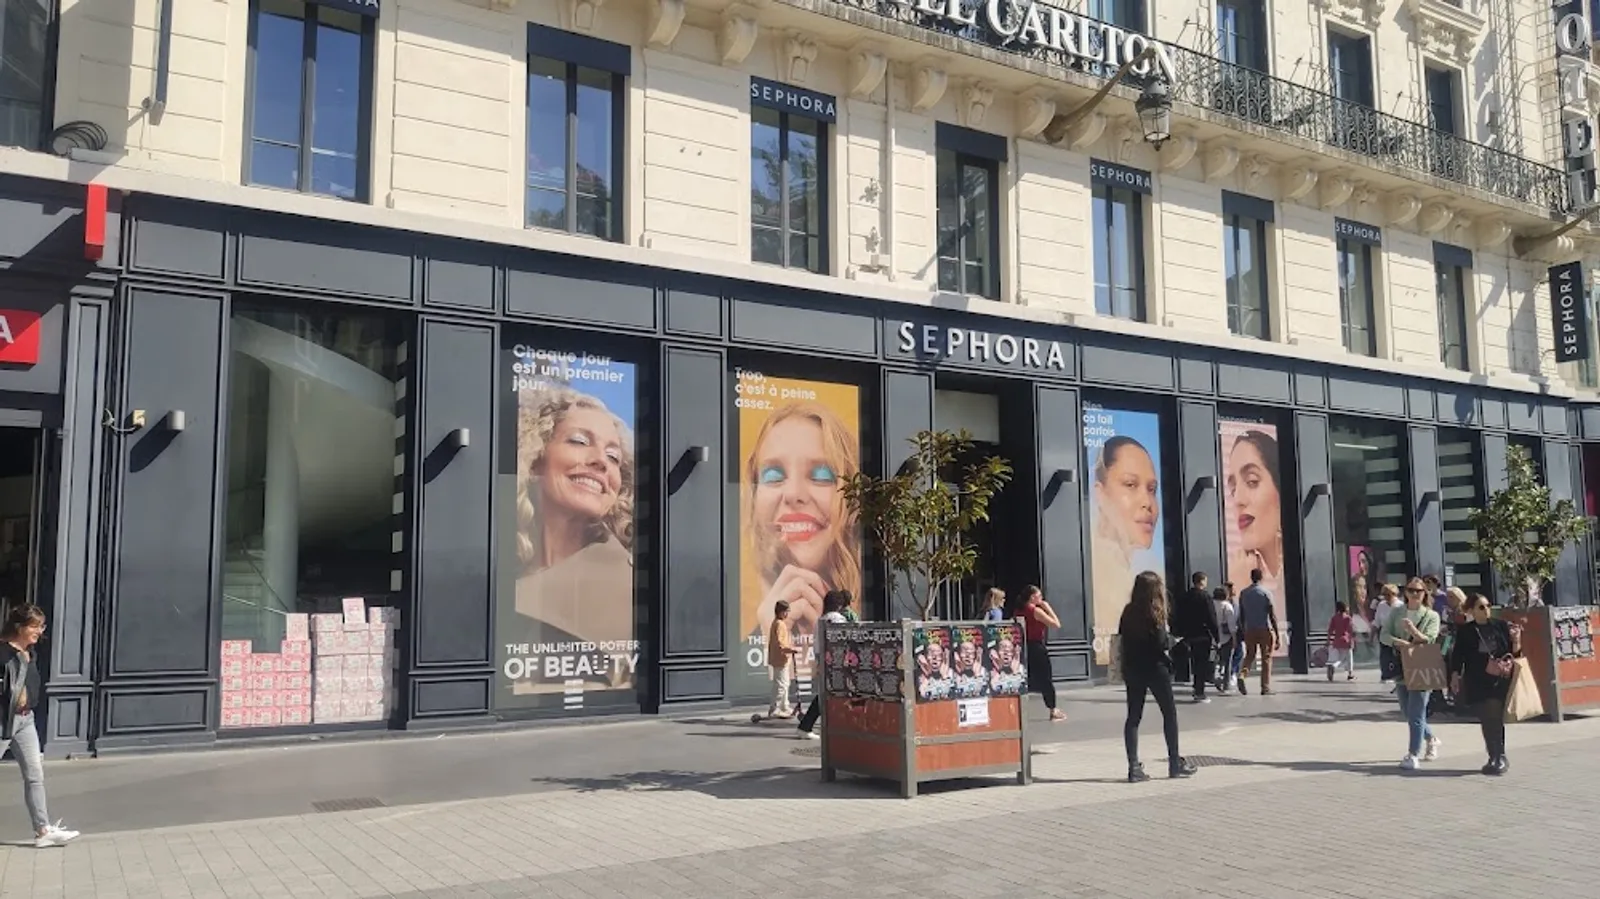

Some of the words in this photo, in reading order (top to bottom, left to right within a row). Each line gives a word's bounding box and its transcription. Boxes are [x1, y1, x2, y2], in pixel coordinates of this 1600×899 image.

[987, 0, 1176, 83] CARLTON
[751, 83, 835, 116] SEPHORA
[1091, 164, 1151, 188] SEPHORA
[1335, 221, 1380, 241] SEPHORA
[1559, 269, 1577, 355] SEPHORA
[512, 344, 577, 363] Chaque
[581, 351, 611, 366] jour
[899, 321, 1065, 370] SEPHORA
[512, 361, 537, 374] est
[541, 364, 560, 377] un
[565, 365, 624, 383] premier
[769, 384, 777, 396] à
[781, 388, 817, 400] peine
[505, 643, 530, 654] THE
[532, 641, 597, 653] UNLIMITED
[599, 639, 641, 651] POWER
[747, 635, 767, 645] THE
[503, 656, 539, 680] OF
[544, 653, 640, 677] BEAUTY
